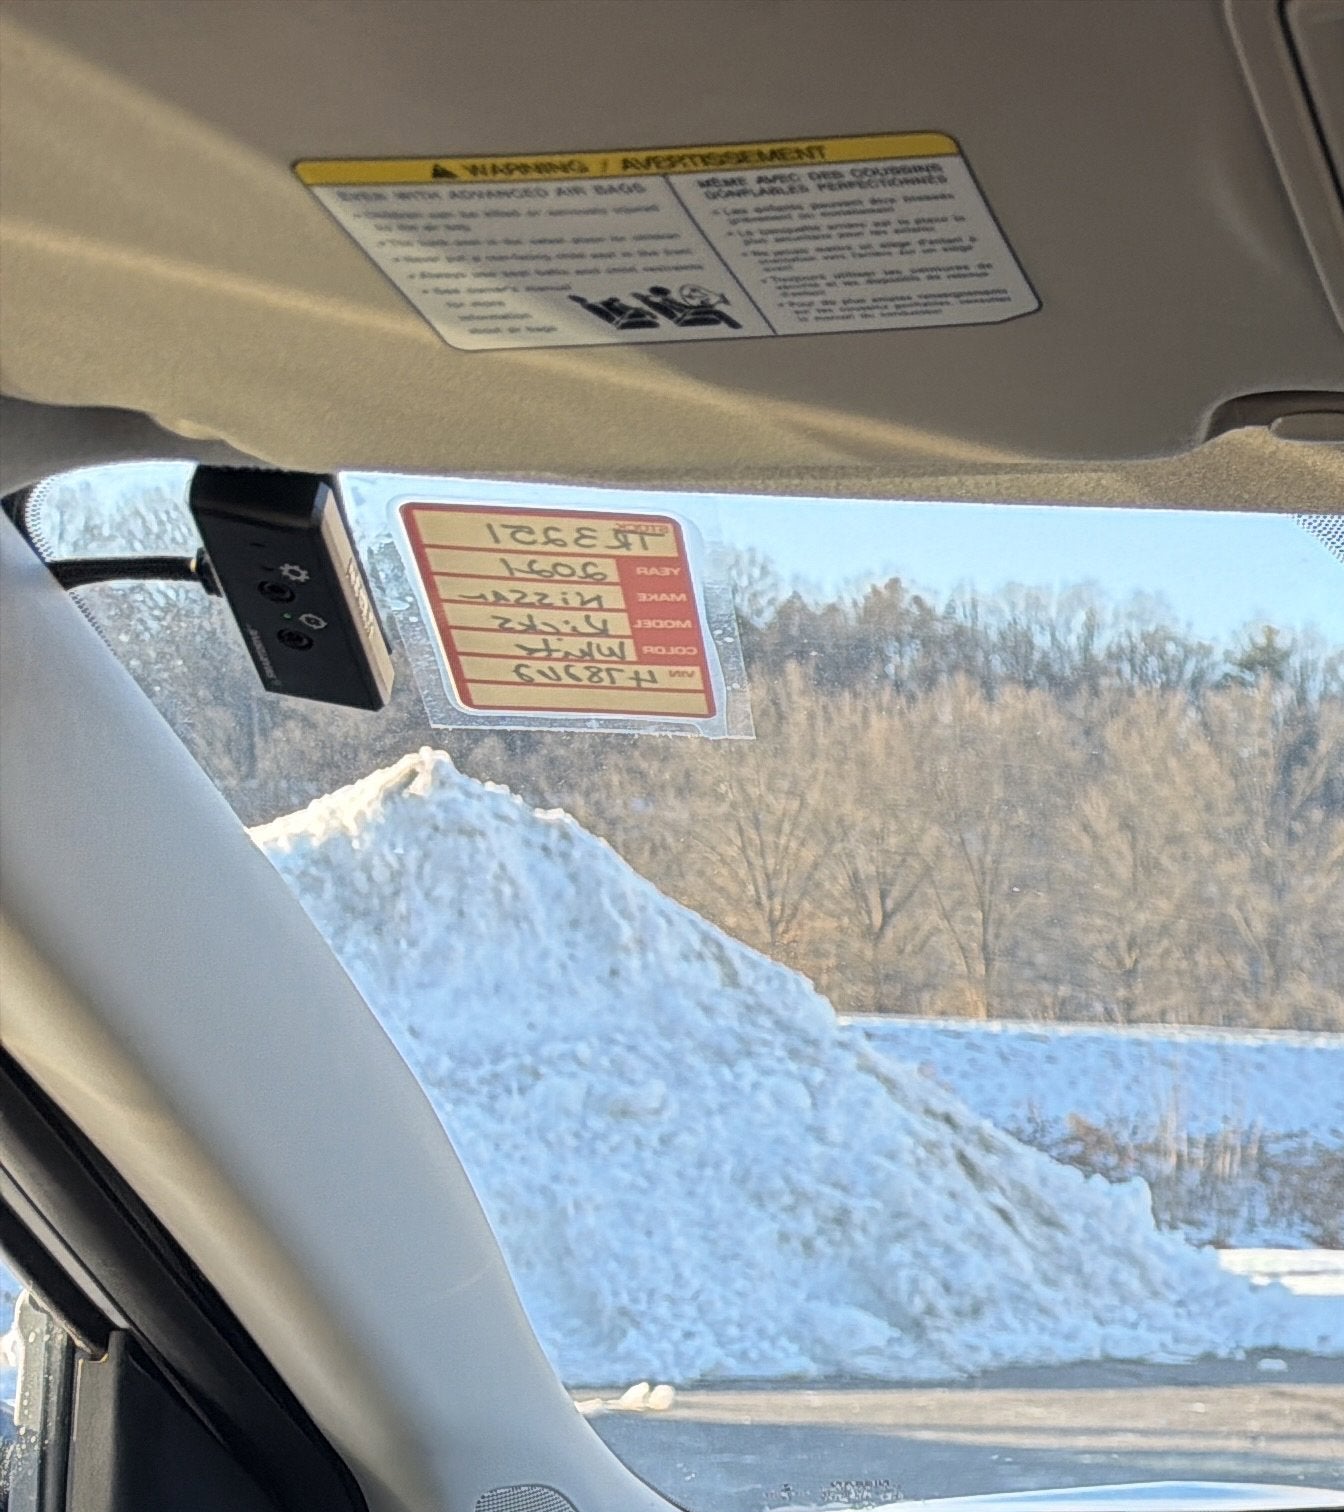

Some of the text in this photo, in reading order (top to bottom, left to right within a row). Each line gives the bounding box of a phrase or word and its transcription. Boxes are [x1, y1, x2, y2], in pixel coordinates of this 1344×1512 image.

[464, 159, 588, 177] WARNING
[621, 144, 828, 172] AVERTISSEMENT
[756, 172, 799, 186] AVEC
[395, 188, 442, 201] WITH
[448, 185, 549, 200] ADVANCED
[556, 183, 587, 197] AIR
[594, 182, 648, 196] BAGS
